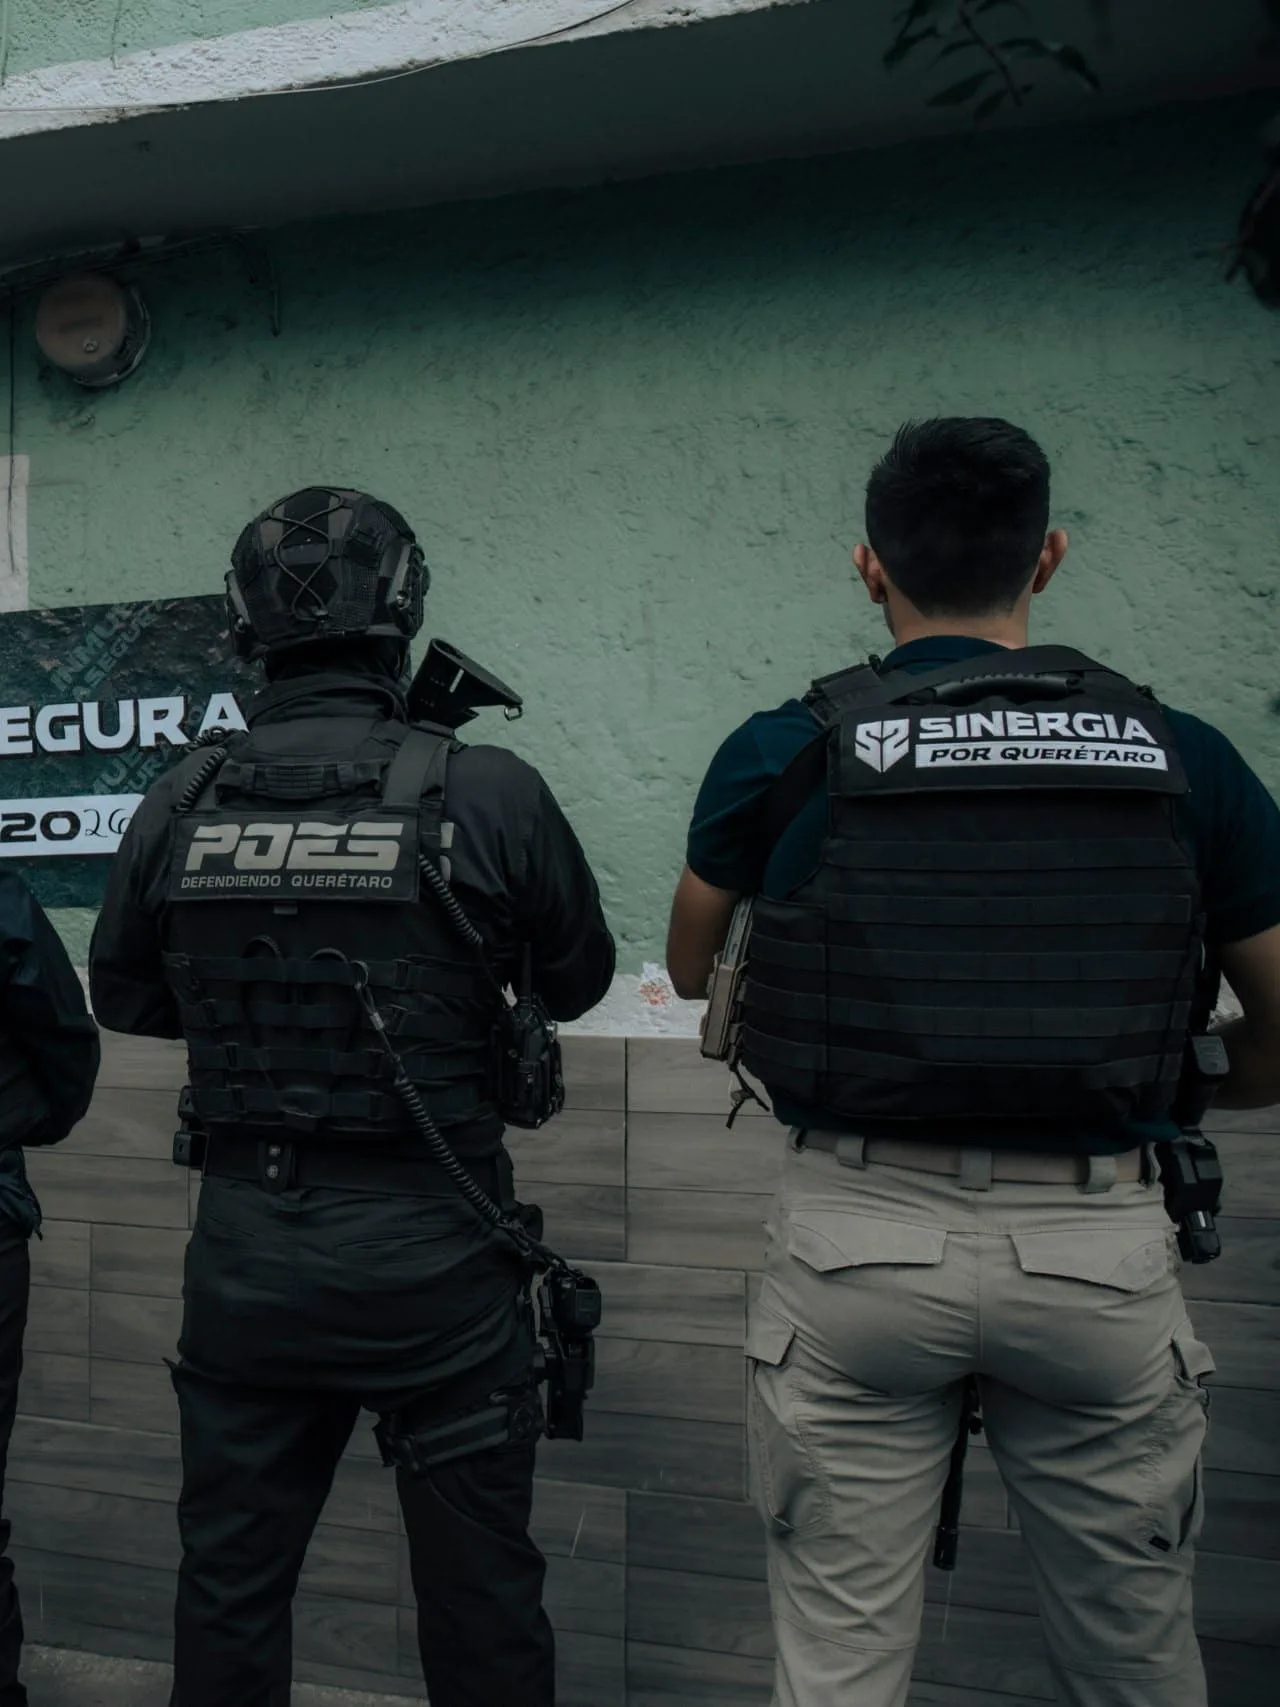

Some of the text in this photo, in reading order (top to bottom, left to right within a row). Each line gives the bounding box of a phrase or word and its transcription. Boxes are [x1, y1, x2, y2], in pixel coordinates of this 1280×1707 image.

[919, 711, 1158, 745] SINERGIA
[930, 746, 1157, 764] POR QUERÉTARO
[185, 822, 404, 872] POES
[181, 873, 392, 889] DEFENDIENDO QUERÉTARO
